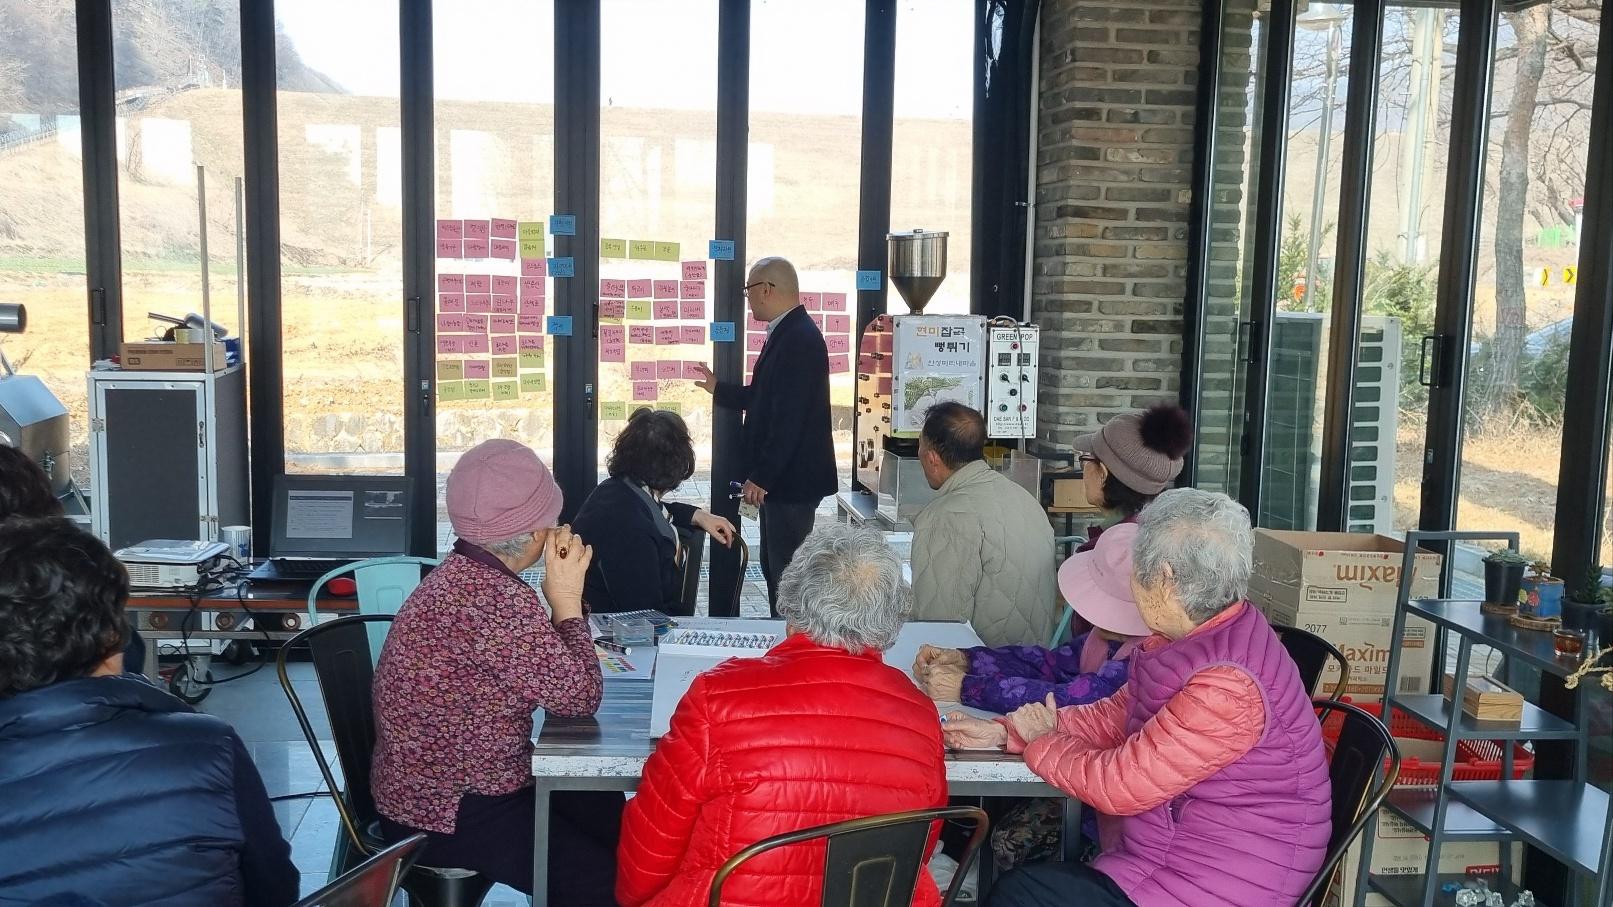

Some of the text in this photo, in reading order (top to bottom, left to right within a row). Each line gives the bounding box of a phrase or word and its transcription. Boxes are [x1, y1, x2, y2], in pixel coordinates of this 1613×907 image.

[996, 333, 1033, 341] GREEN POP
[934, 341, 970, 353] 뻥튀기
[1304, 624, 1328, 634] 2077
